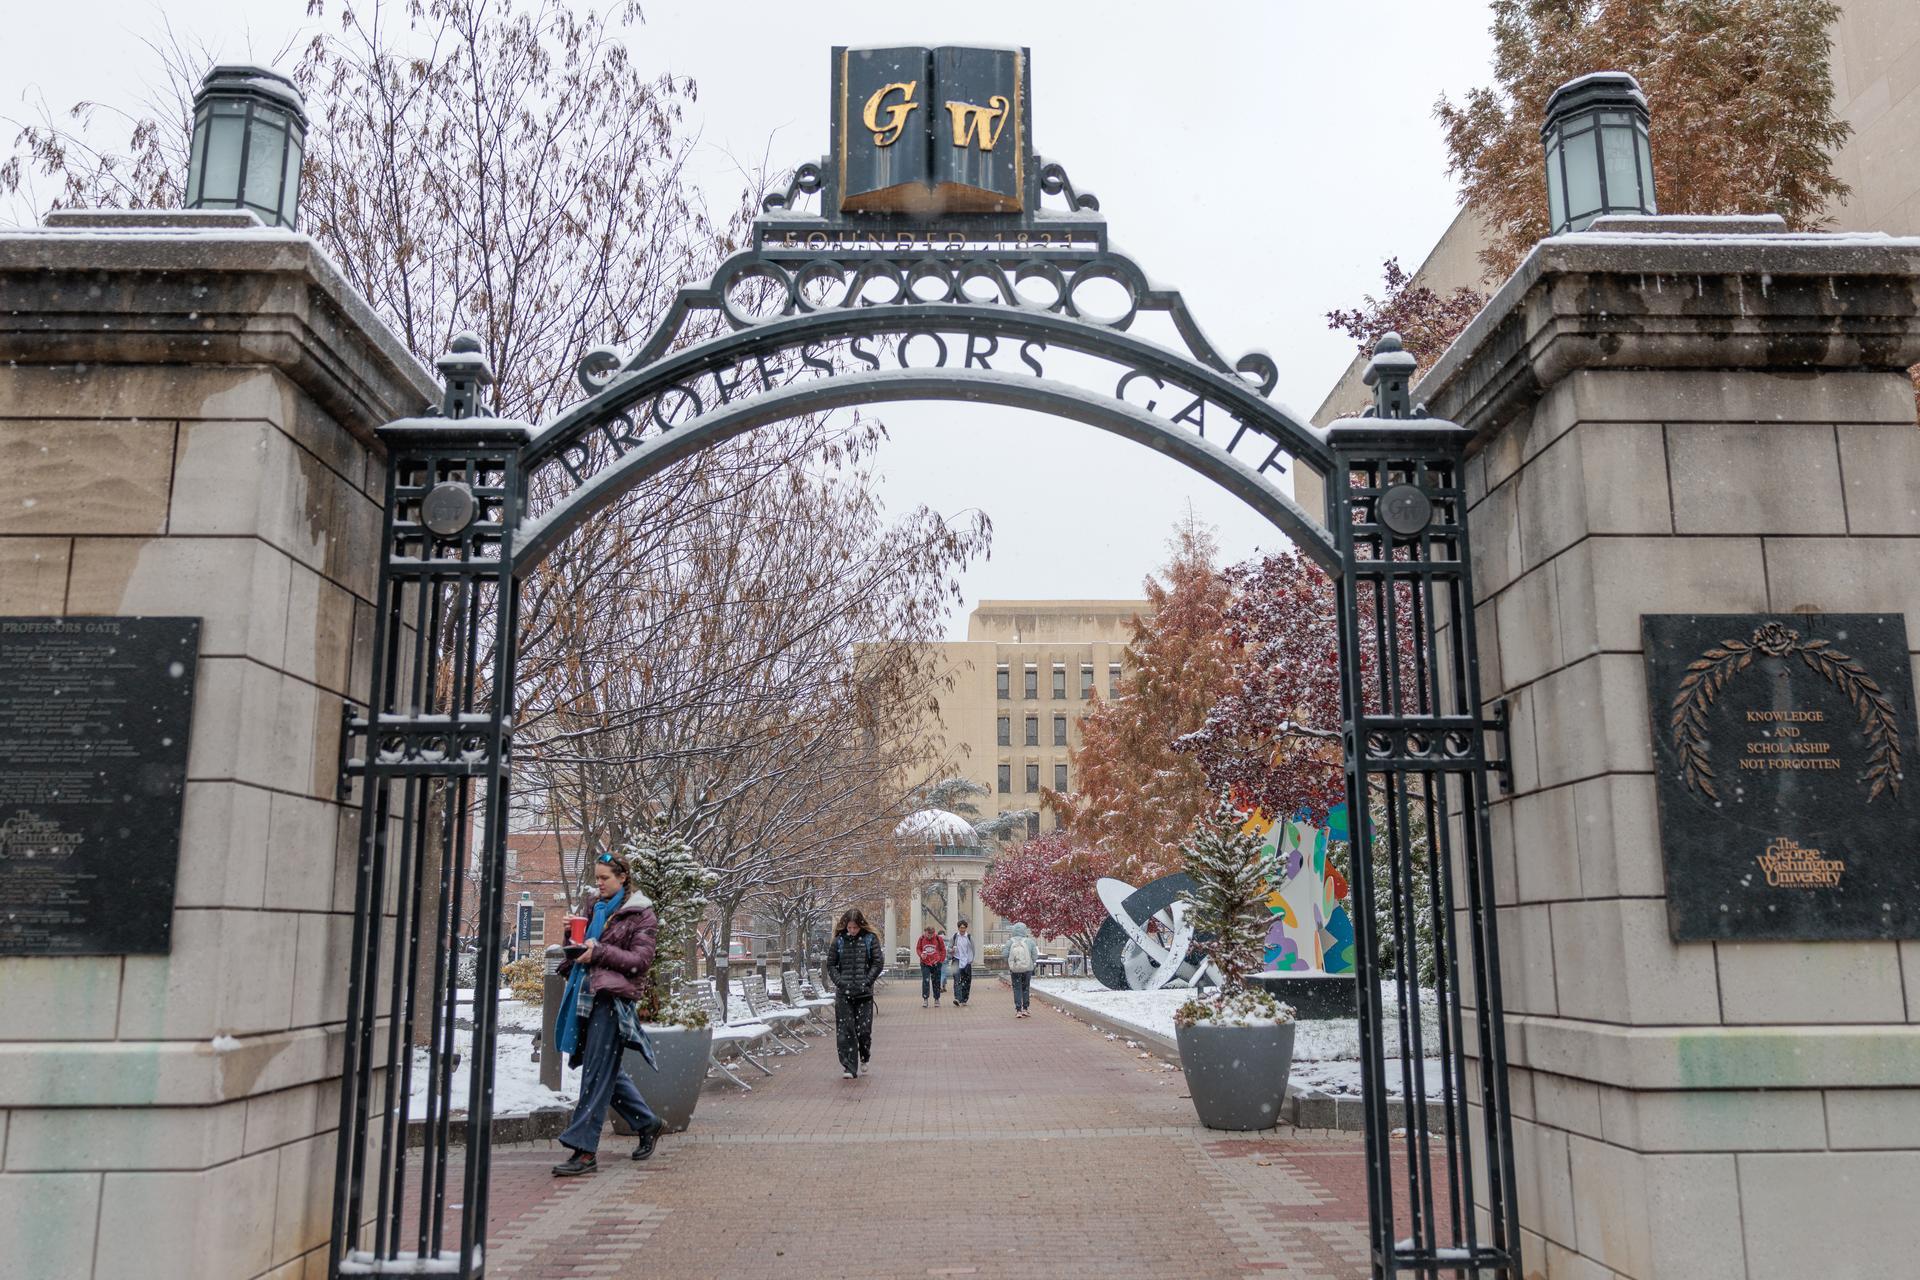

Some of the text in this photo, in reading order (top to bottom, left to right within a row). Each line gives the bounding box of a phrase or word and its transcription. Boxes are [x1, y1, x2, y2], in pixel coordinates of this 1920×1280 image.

[784, 231, 1073, 251] FOUNDED 1821
[555, 330, 1298, 487] PROFESSORS GATE
[2, 622, 121, 634] PROFESSORS GATE
[1746, 711, 1825, 722] KNOWLEDGE
[1774, 727, 1801, 738] AND
[1746, 742, 1831, 754] SCHOLARSHIP
[1739, 758, 1841, 770] NOT FORGOTTEN
[1775, 837, 1800, 849] The
[1765, 845, 1821, 861] George
[1755, 855, 1845, 873] Washington
[1765, 869, 1840, 887] University
